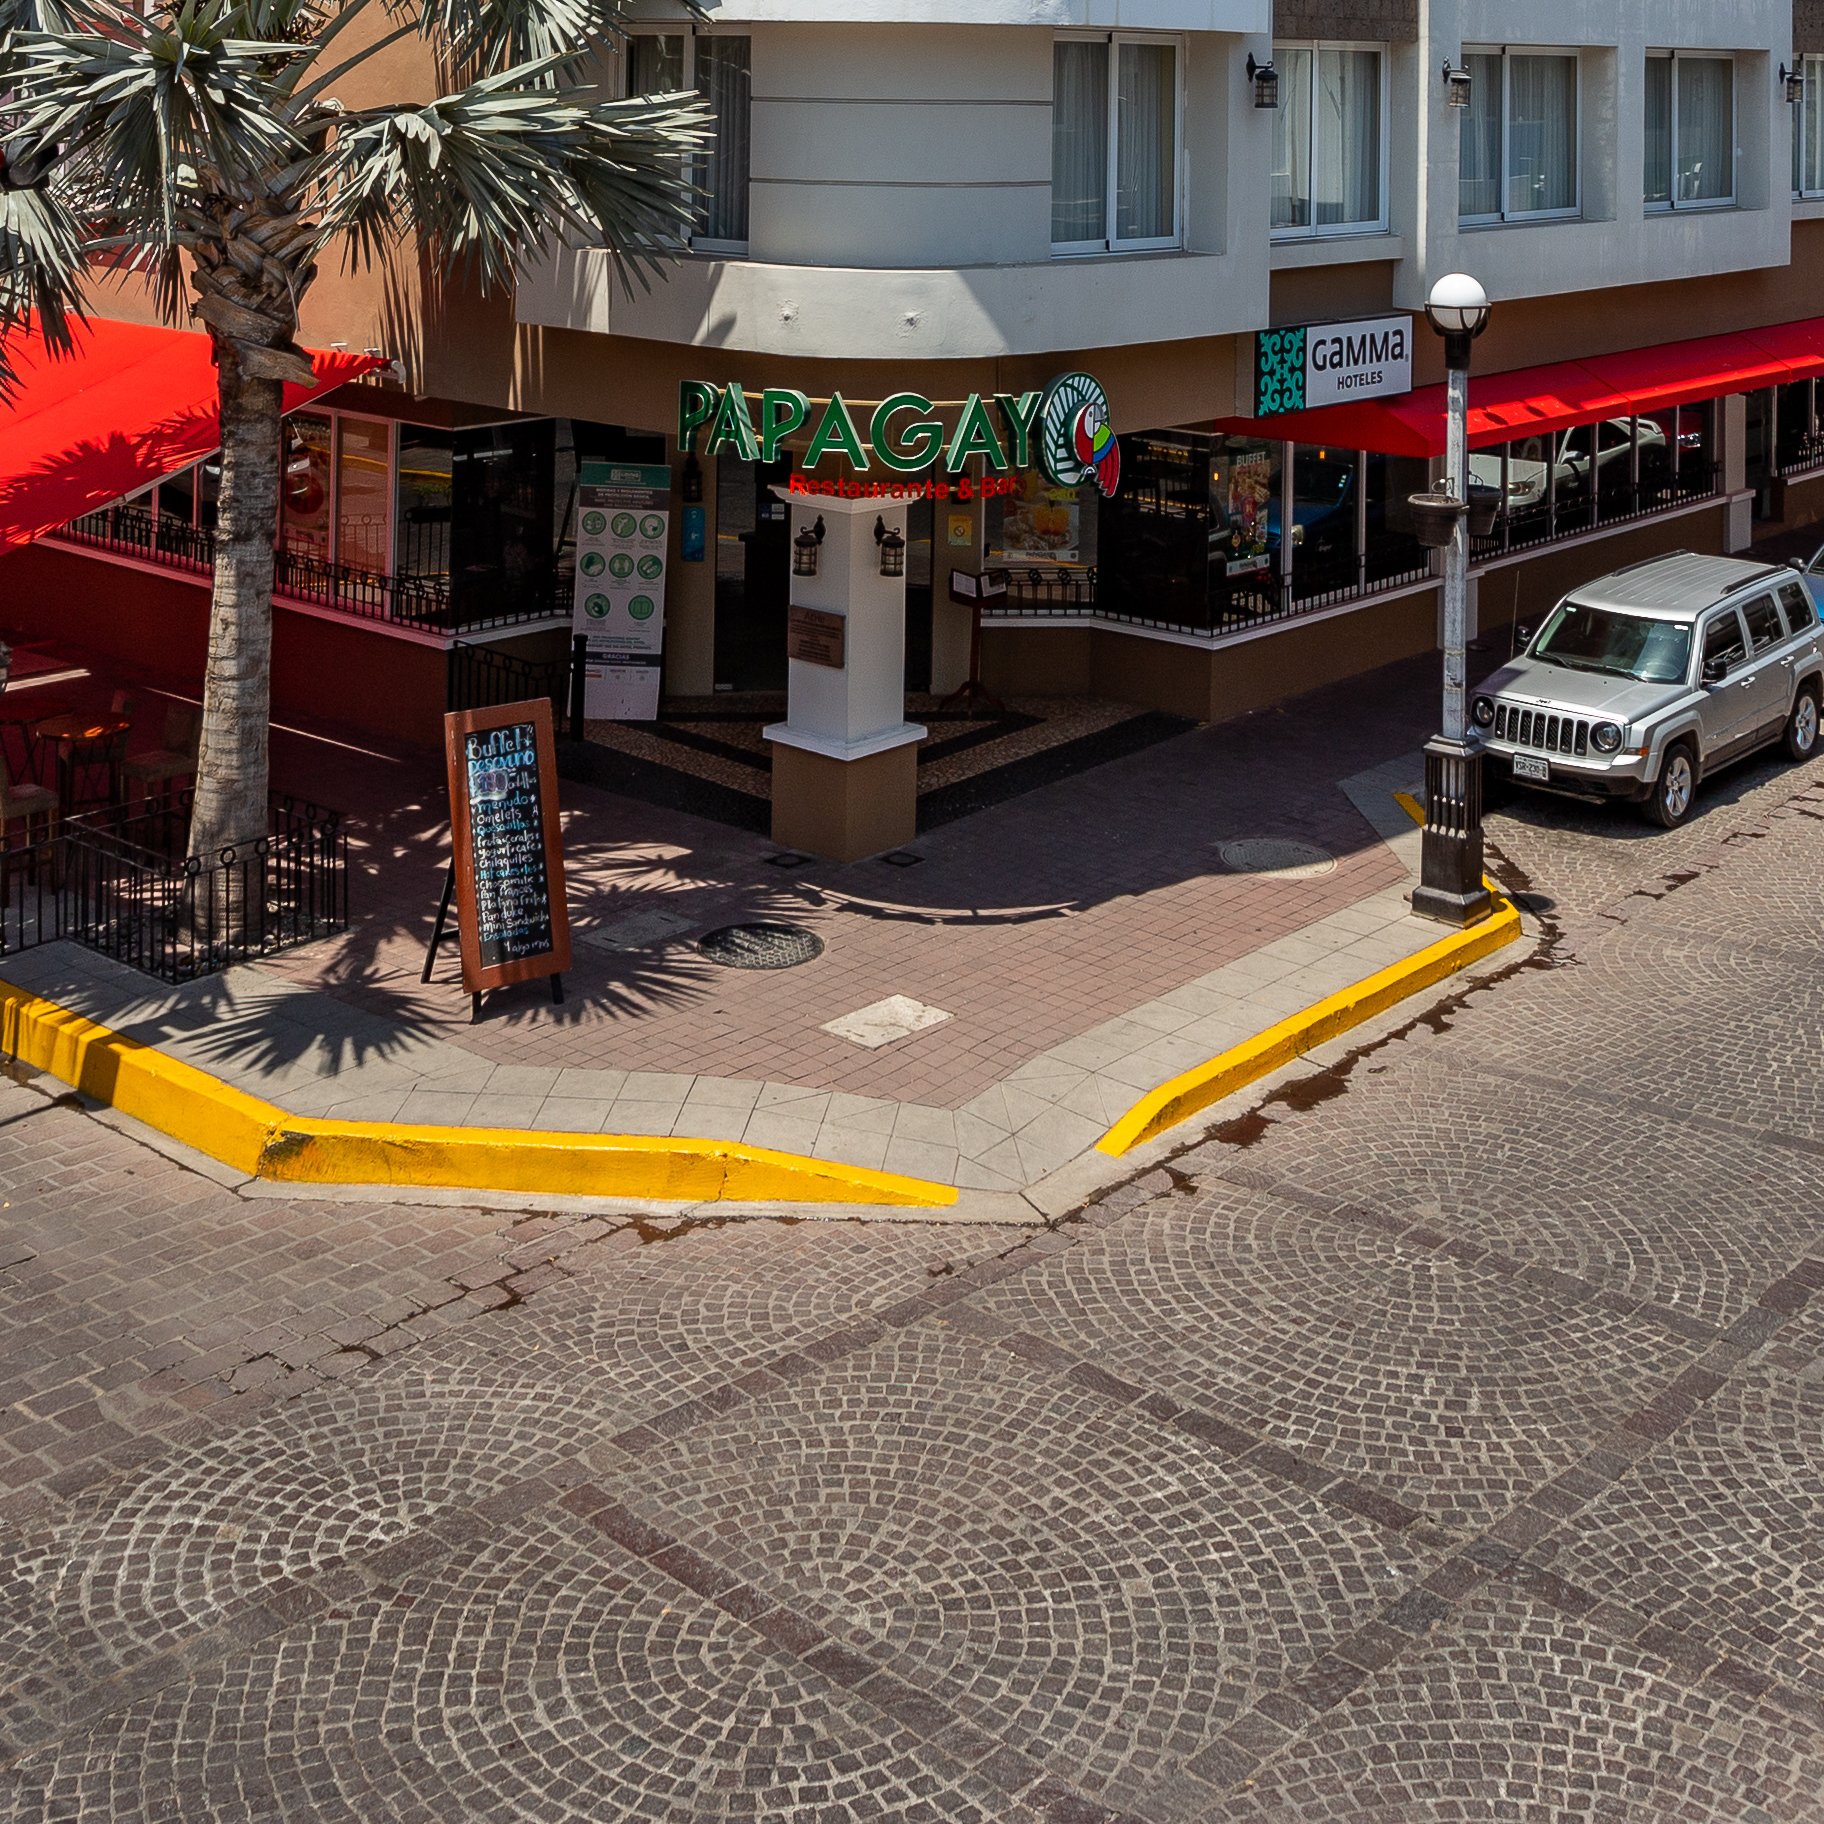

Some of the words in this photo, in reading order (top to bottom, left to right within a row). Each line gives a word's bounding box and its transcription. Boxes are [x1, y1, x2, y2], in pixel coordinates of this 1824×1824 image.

[1337, 370, 1383, 390] HOTELES
[1236, 451, 1266, 466] BUFFET
[789, 473, 947, 501] Restaurante
[956, 477, 975, 500] &
[980, 475, 1018, 499] Bar
